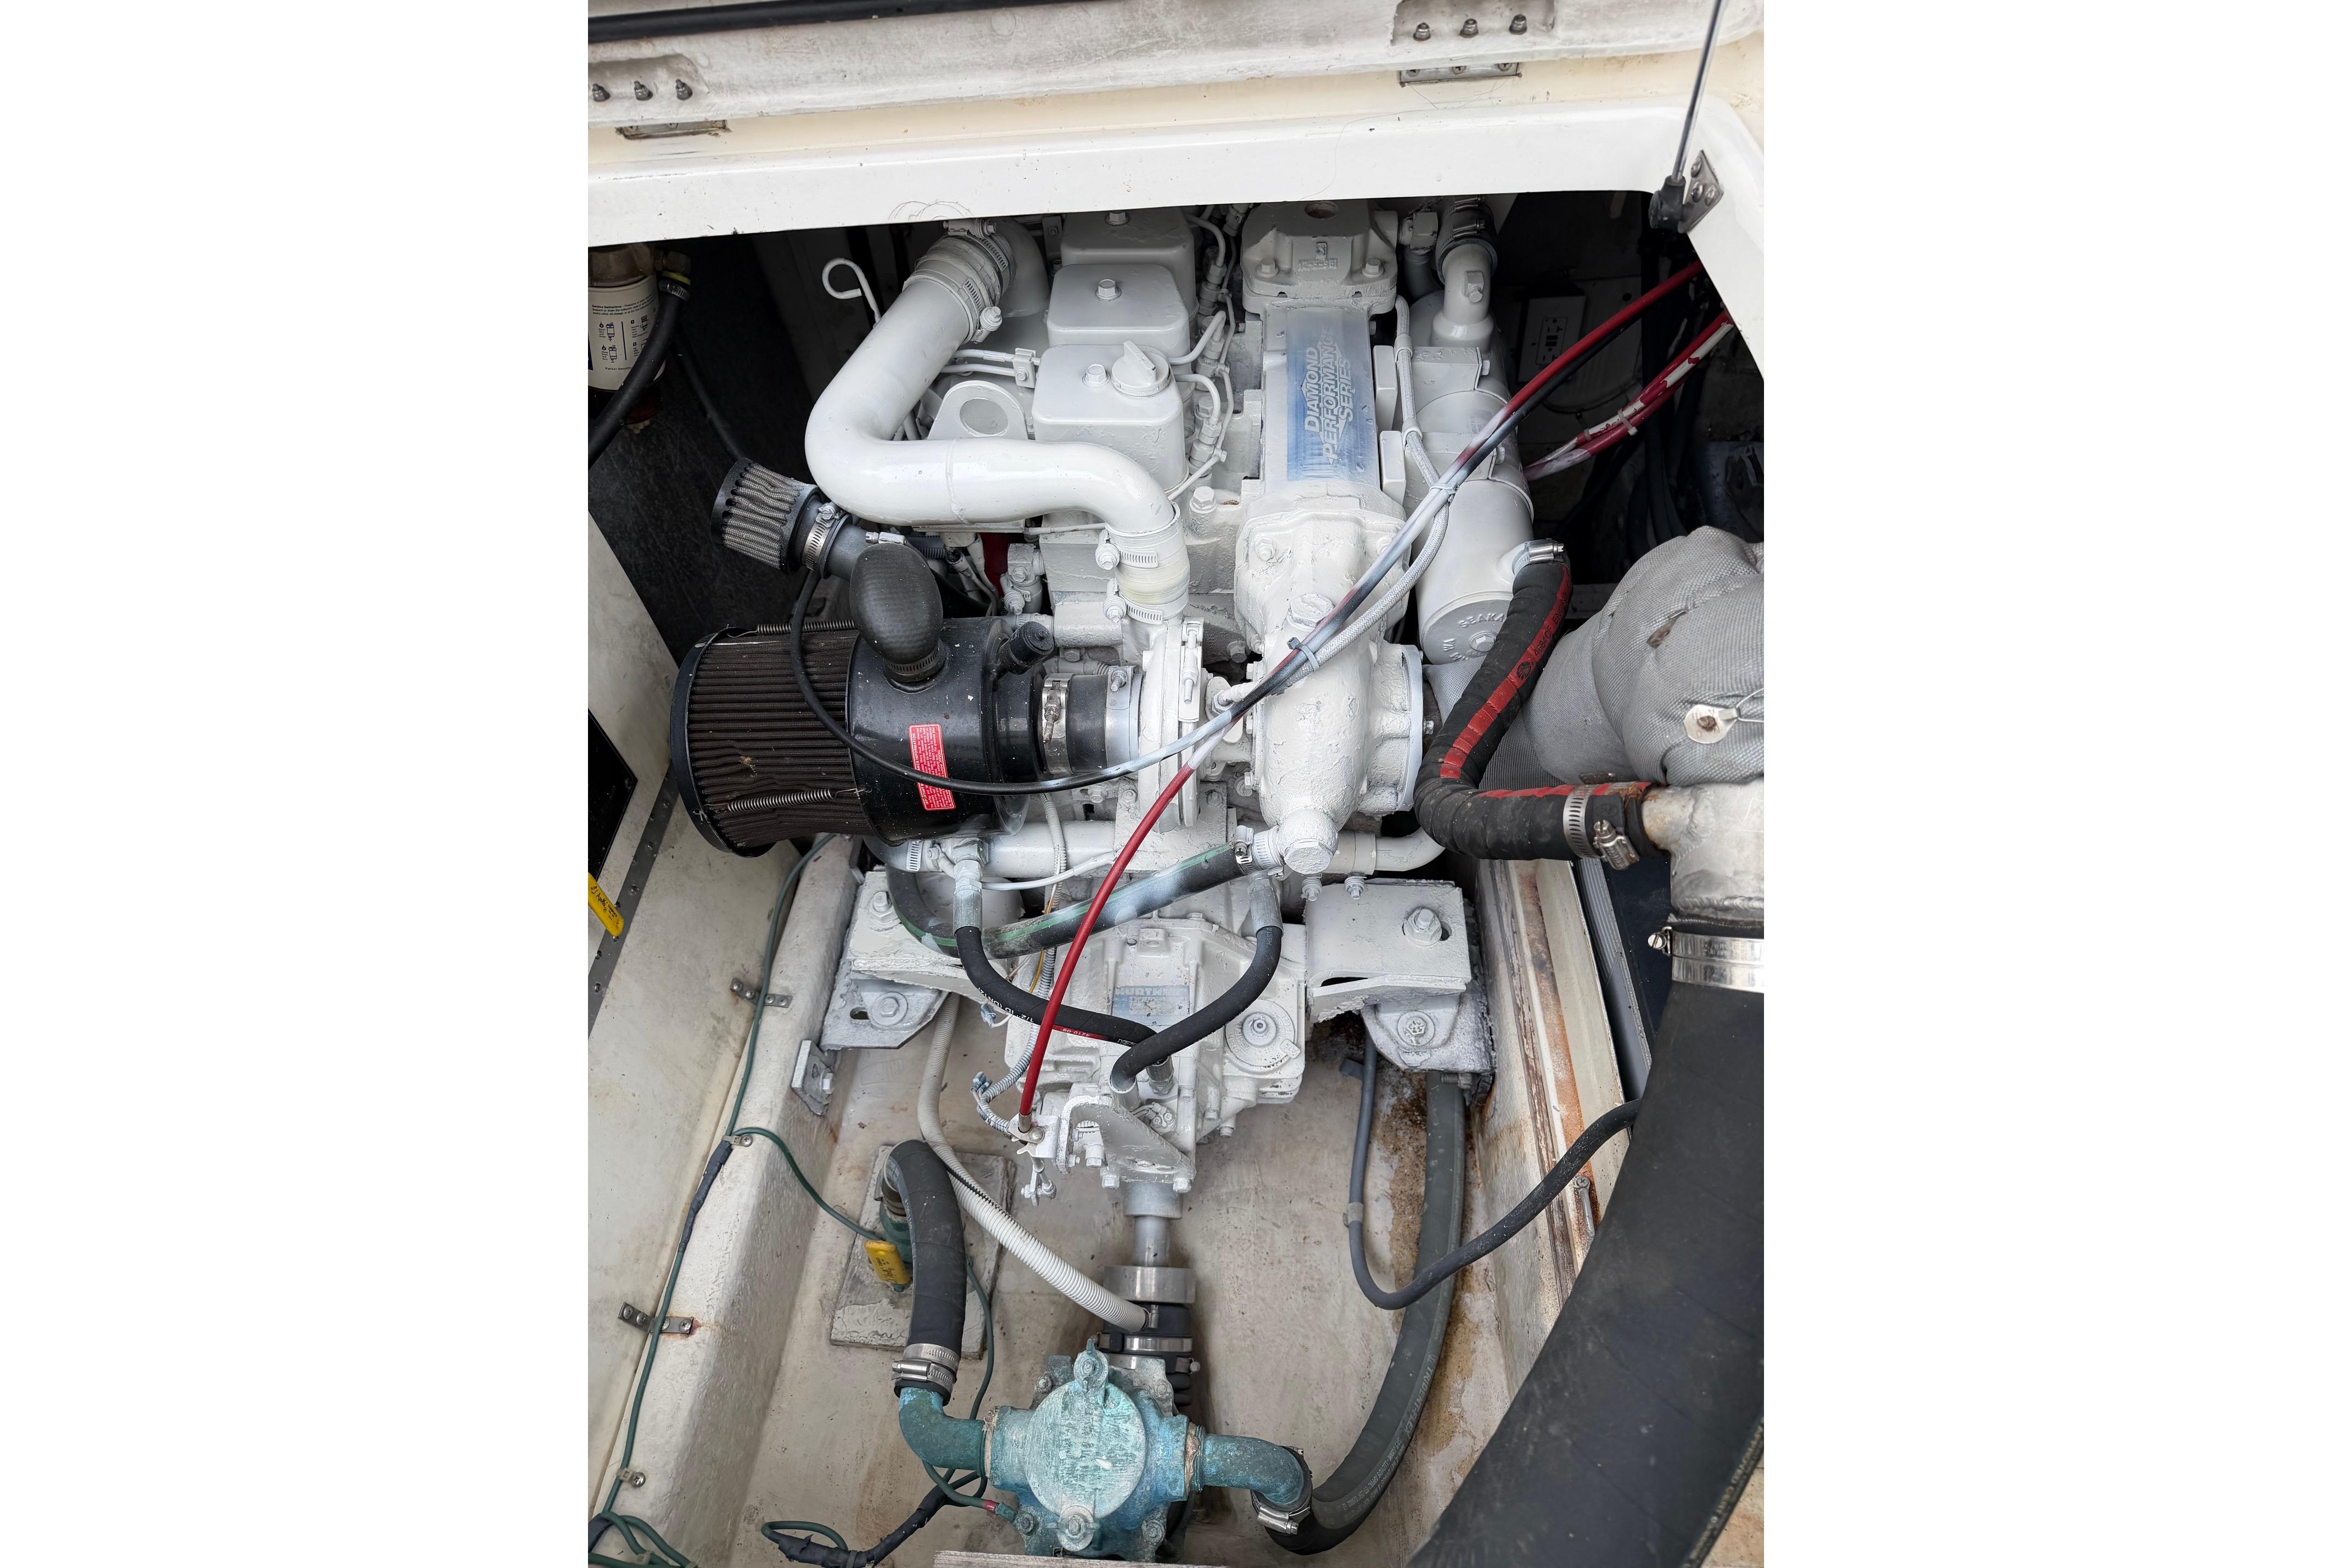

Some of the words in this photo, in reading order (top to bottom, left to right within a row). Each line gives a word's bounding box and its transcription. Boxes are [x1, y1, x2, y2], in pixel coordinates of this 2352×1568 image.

[1304, 347, 1321, 433] DIAMOND
[1322, 325, 1339, 460] PERFORMANCE
[1338, 359, 1354, 422] SERIES
[1062, 1028, 1090, 1037] 4210-08
[1281, 1012, 1293, 1033] PULL
